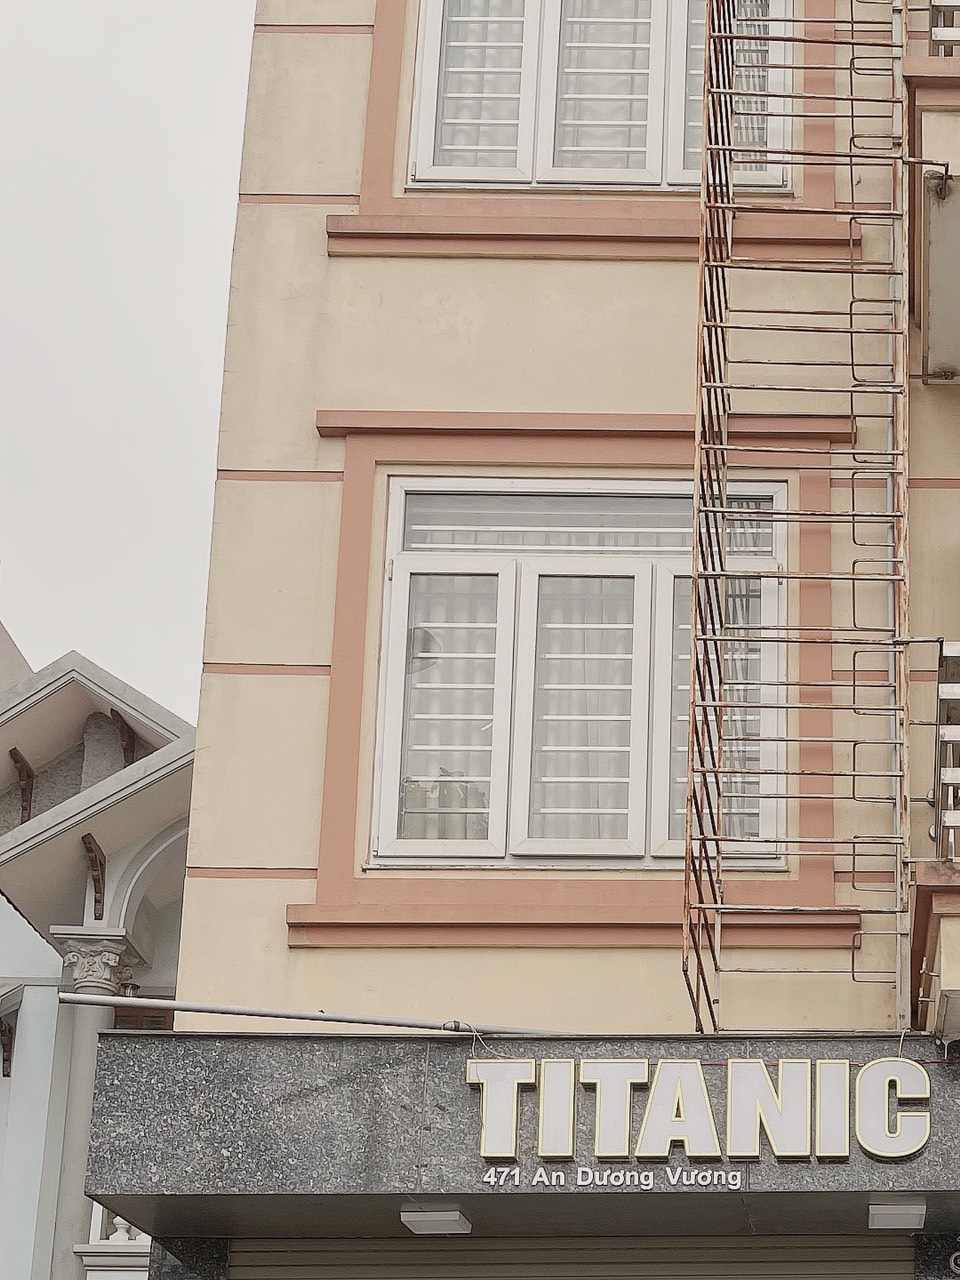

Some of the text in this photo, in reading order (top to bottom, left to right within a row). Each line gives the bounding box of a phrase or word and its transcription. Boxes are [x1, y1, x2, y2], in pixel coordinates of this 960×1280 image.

[466, 1057, 932, 1161] TITANIC
[483, 1166, 742, 1190] 471 An Dương Vương
